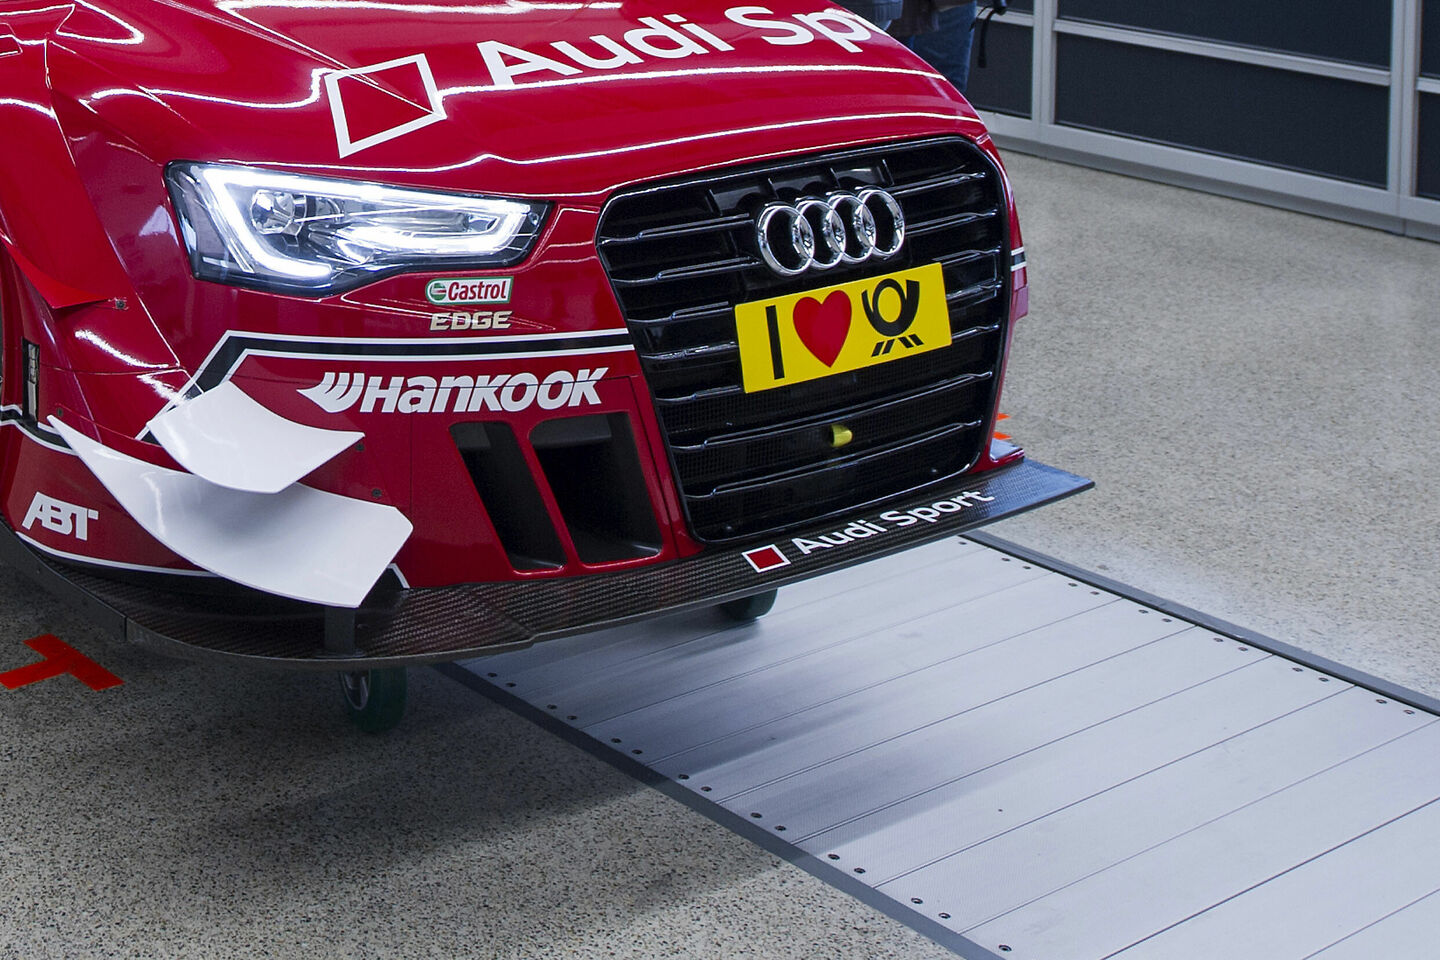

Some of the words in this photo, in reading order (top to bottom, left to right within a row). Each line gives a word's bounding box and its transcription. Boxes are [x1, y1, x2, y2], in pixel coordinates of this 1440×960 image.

[476, 13, 735, 86] Audi
[448, 280, 507, 301] Castrol
[429, 310, 513, 330] EDGE
[765, 304, 785, 380] I
[21, 491, 99, 541] ABT
[791, 519, 888, 555] Audi
[879, 489, 995, 527] Sport
